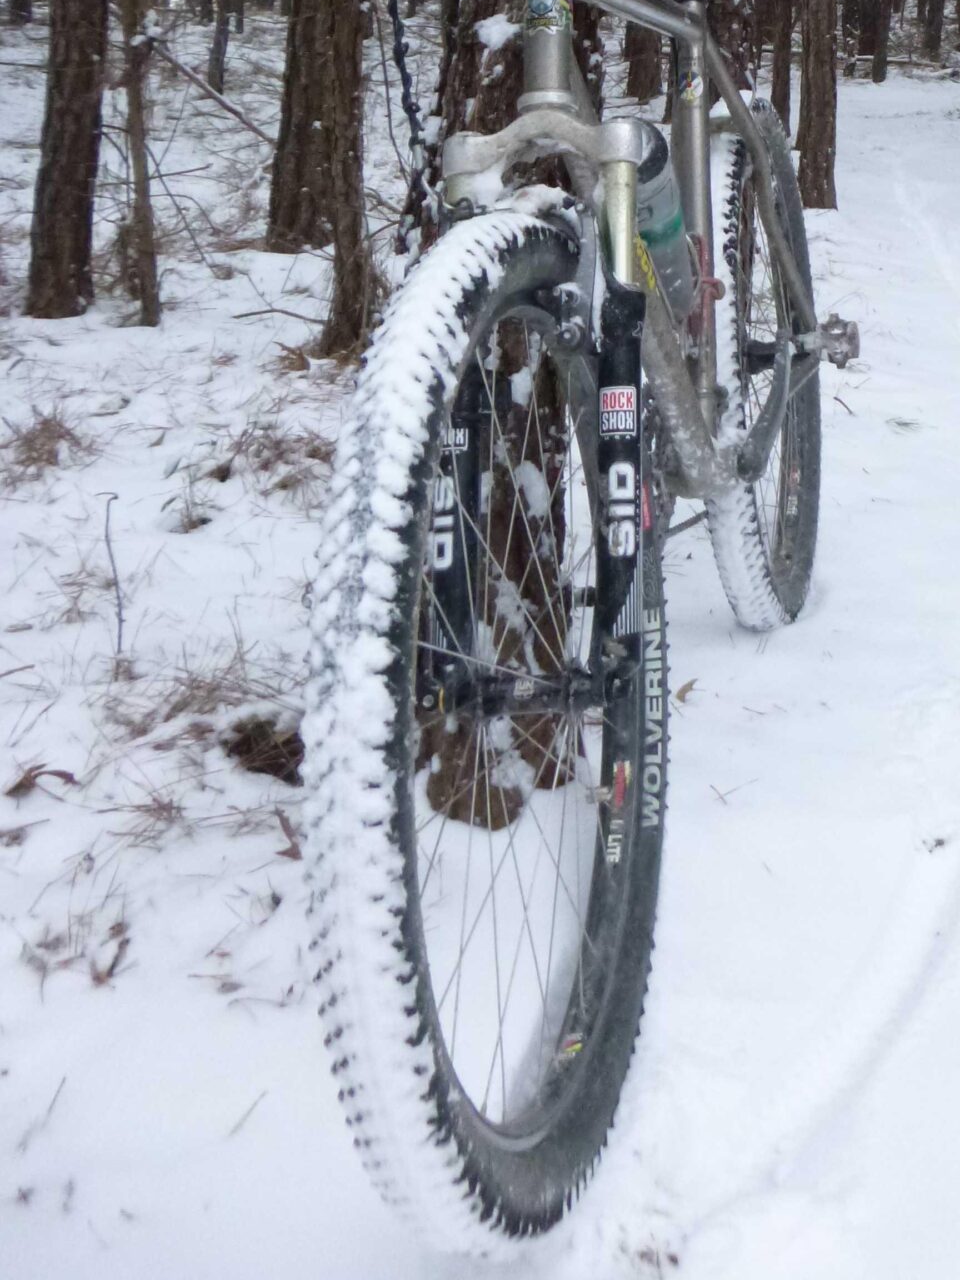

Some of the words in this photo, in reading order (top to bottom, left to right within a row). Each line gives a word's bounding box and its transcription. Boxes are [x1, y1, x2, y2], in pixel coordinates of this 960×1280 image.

[602, 391, 634, 410] ROCK
[602, 411, 634, 431] SHOX
[607, 461, 635, 557] SID
[641, 608, 663, 828] WOLVERINE
